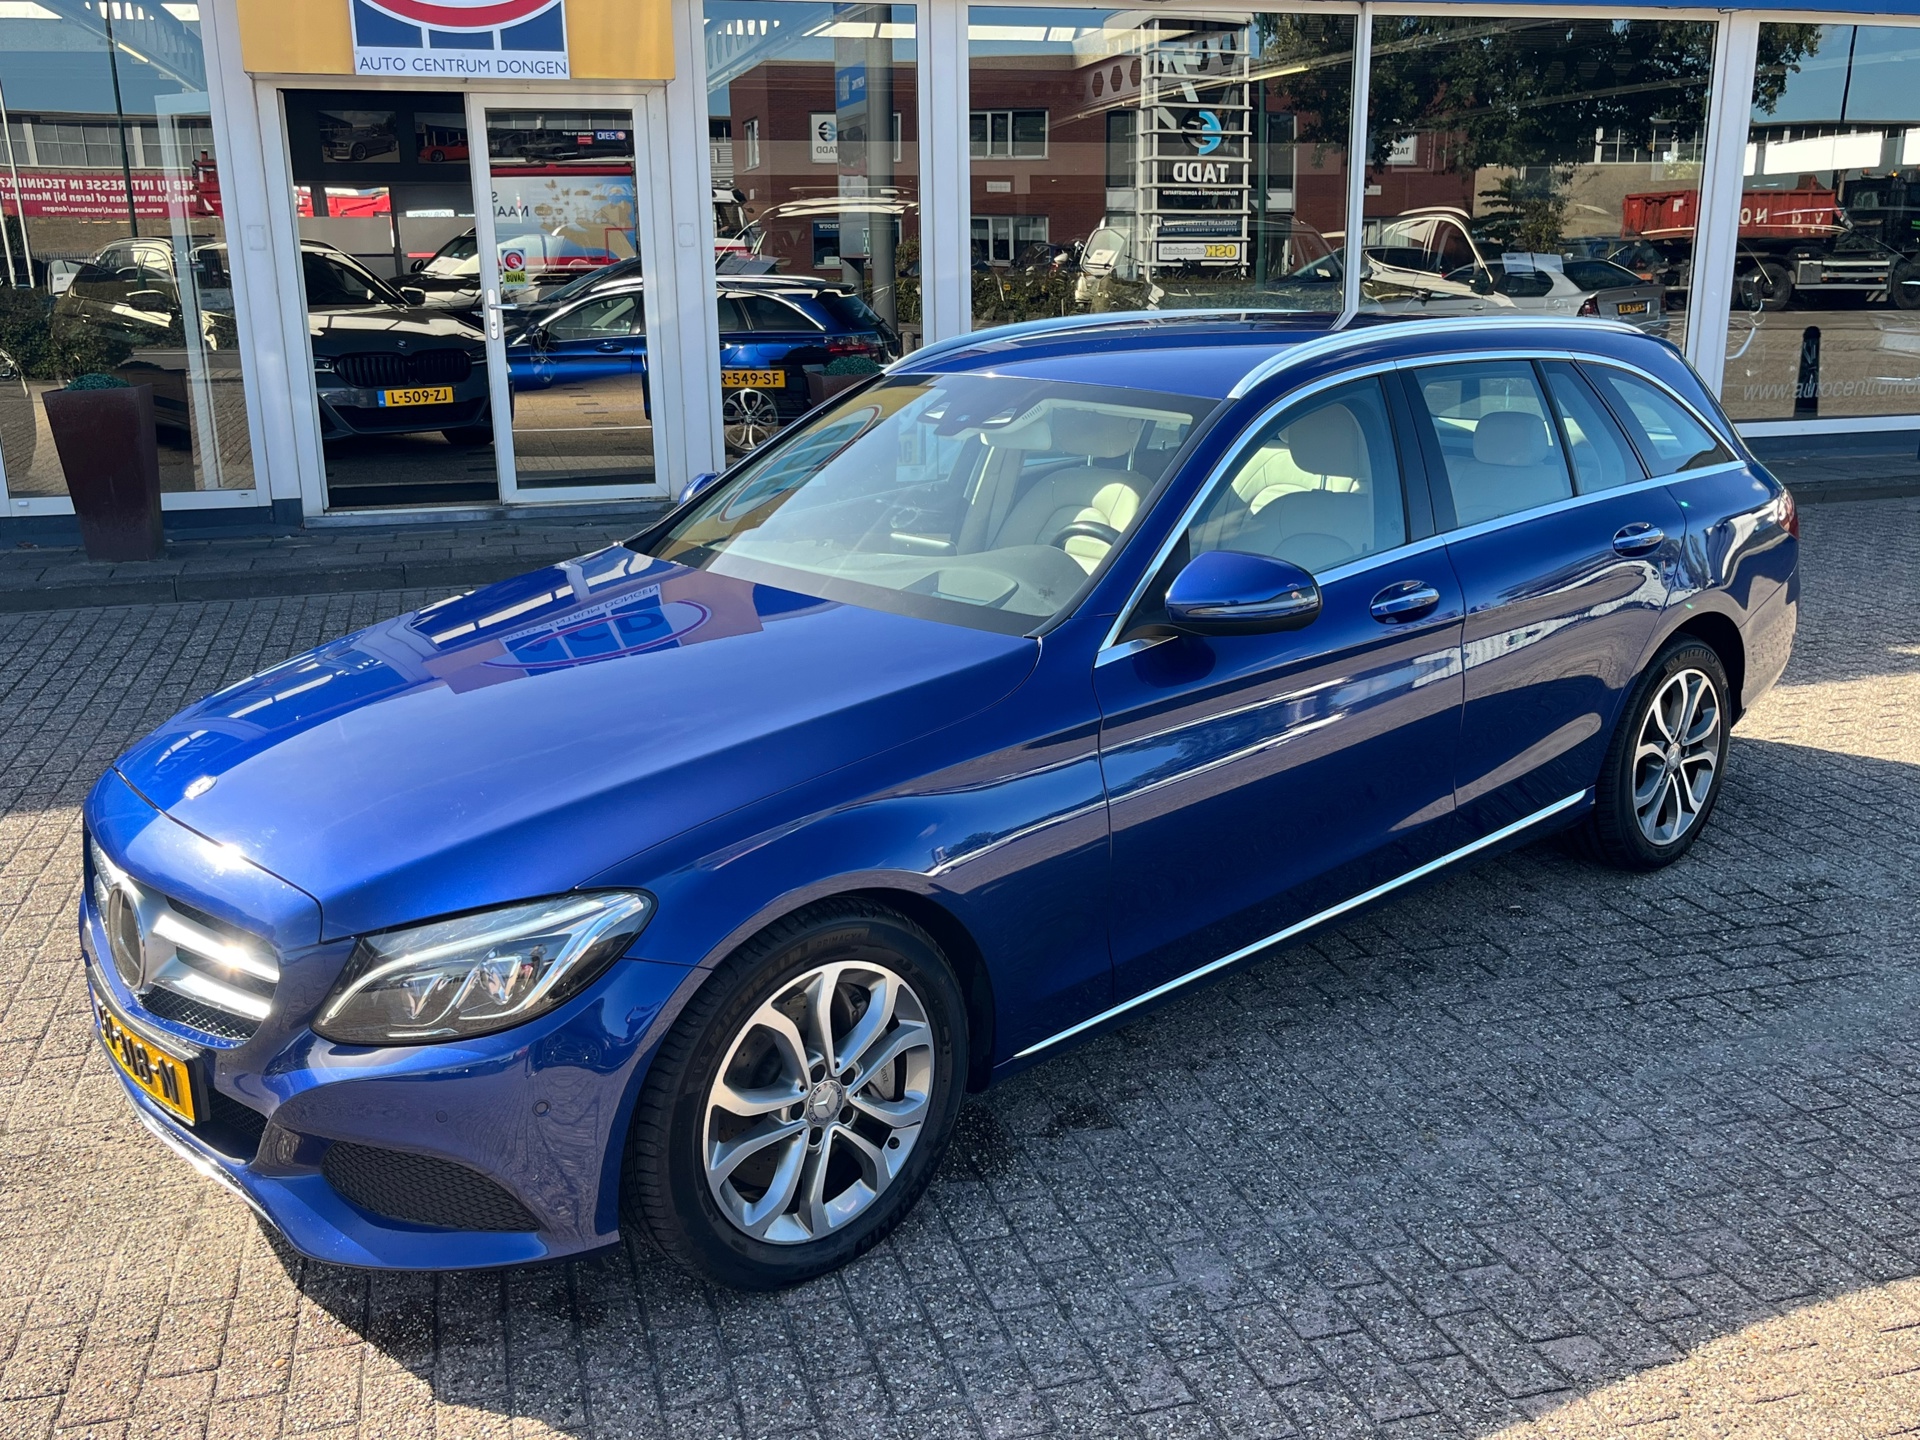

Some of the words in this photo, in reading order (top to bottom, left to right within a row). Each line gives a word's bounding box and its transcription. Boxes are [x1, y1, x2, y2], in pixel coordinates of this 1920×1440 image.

[359, 57, 406, 71] AUTO
[412, 57, 491, 73] CENTRUM
[497, 60, 568, 75] DONGEN
[505, 272, 525, 283] BOVAG
[391, 388, 448, 405] L-509-ZJ
